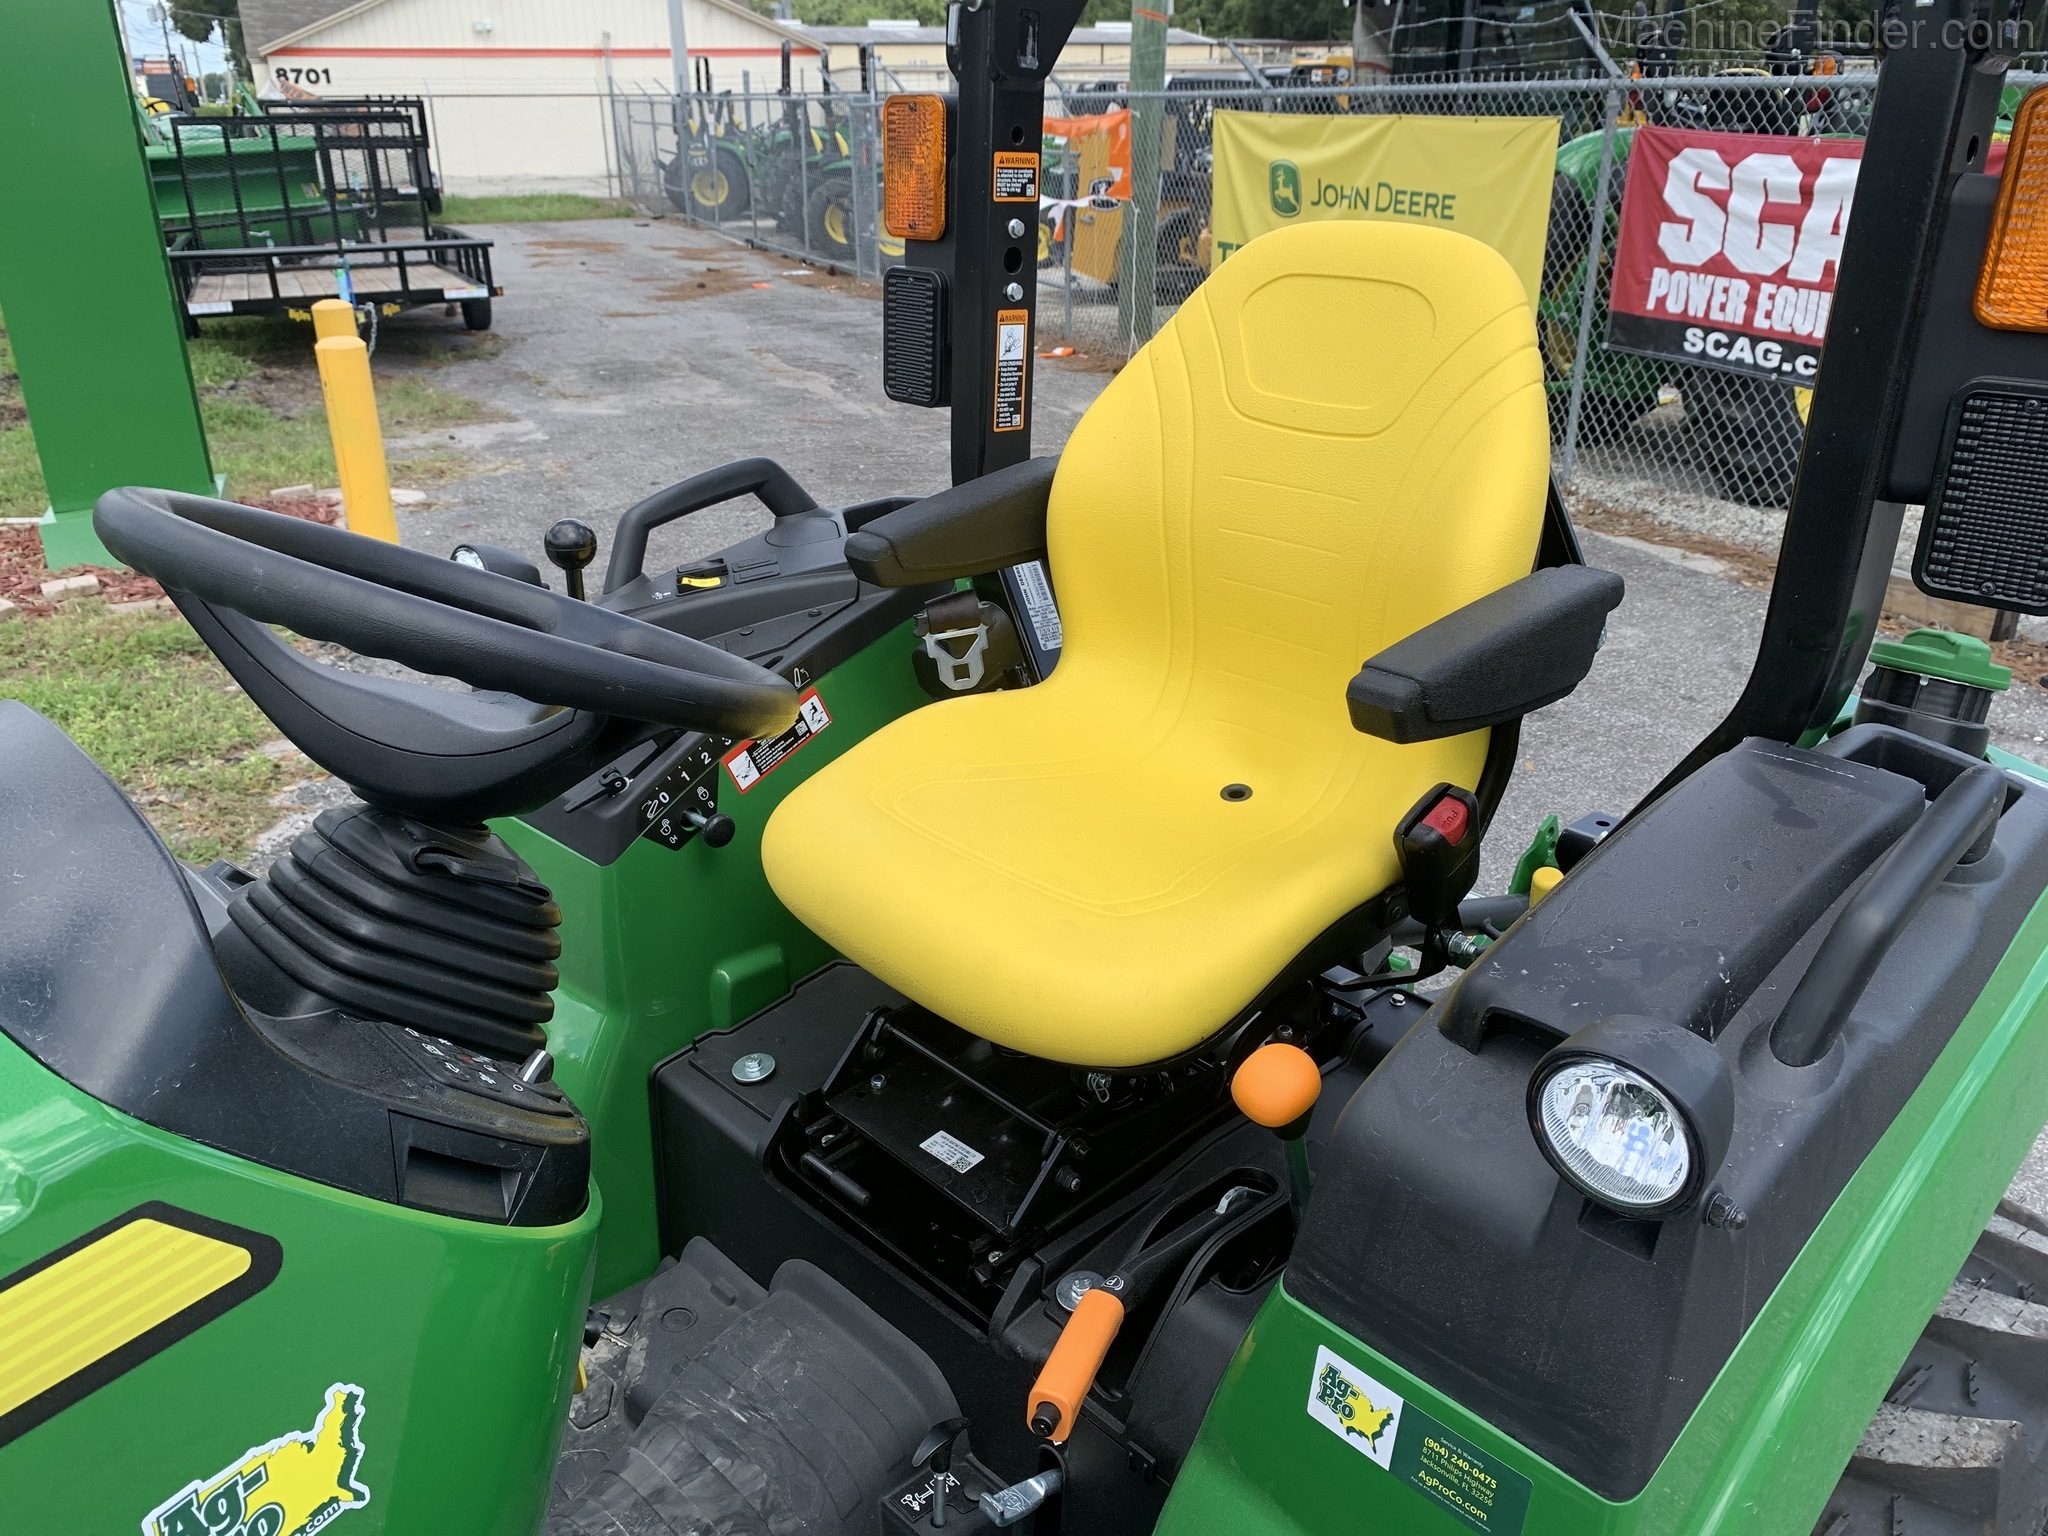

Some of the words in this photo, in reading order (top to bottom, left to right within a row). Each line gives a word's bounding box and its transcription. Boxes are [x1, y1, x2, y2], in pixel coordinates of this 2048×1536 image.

[276, 67, 331, 84] 8701
[1311, 178, 1370, 210] JOHN
[1375, 182, 1456, 220] DEERE
[1646, 267, 1750, 325] POWER
[1023, 589, 1031, 605] JOHN
[659, 792, 670, 803] 0
[681, 771, 690, 781] 1
[701, 752, 712, 764] 2
[1316, 1382, 1355, 1420] Pro
[1320, 1363, 1360, 1398] Ag-
[1420, 1455, 1460, 1486] Jacksonville,
[1462, 1482, 1469, 1492] FL
[1471, 1488, 1493, 1506] 32256
[1423, 1447, 1438, 1462] 8711
[1441, 1458, 1462, 1477] Philips
[1464, 1474, 1494, 1498] Highway
[1424, 1437, 1449, 1458] (904)
[1451, 1454, 1497, 1489] 240-0475
[1419, 1470, 1487, 1521] AgProCo.com
